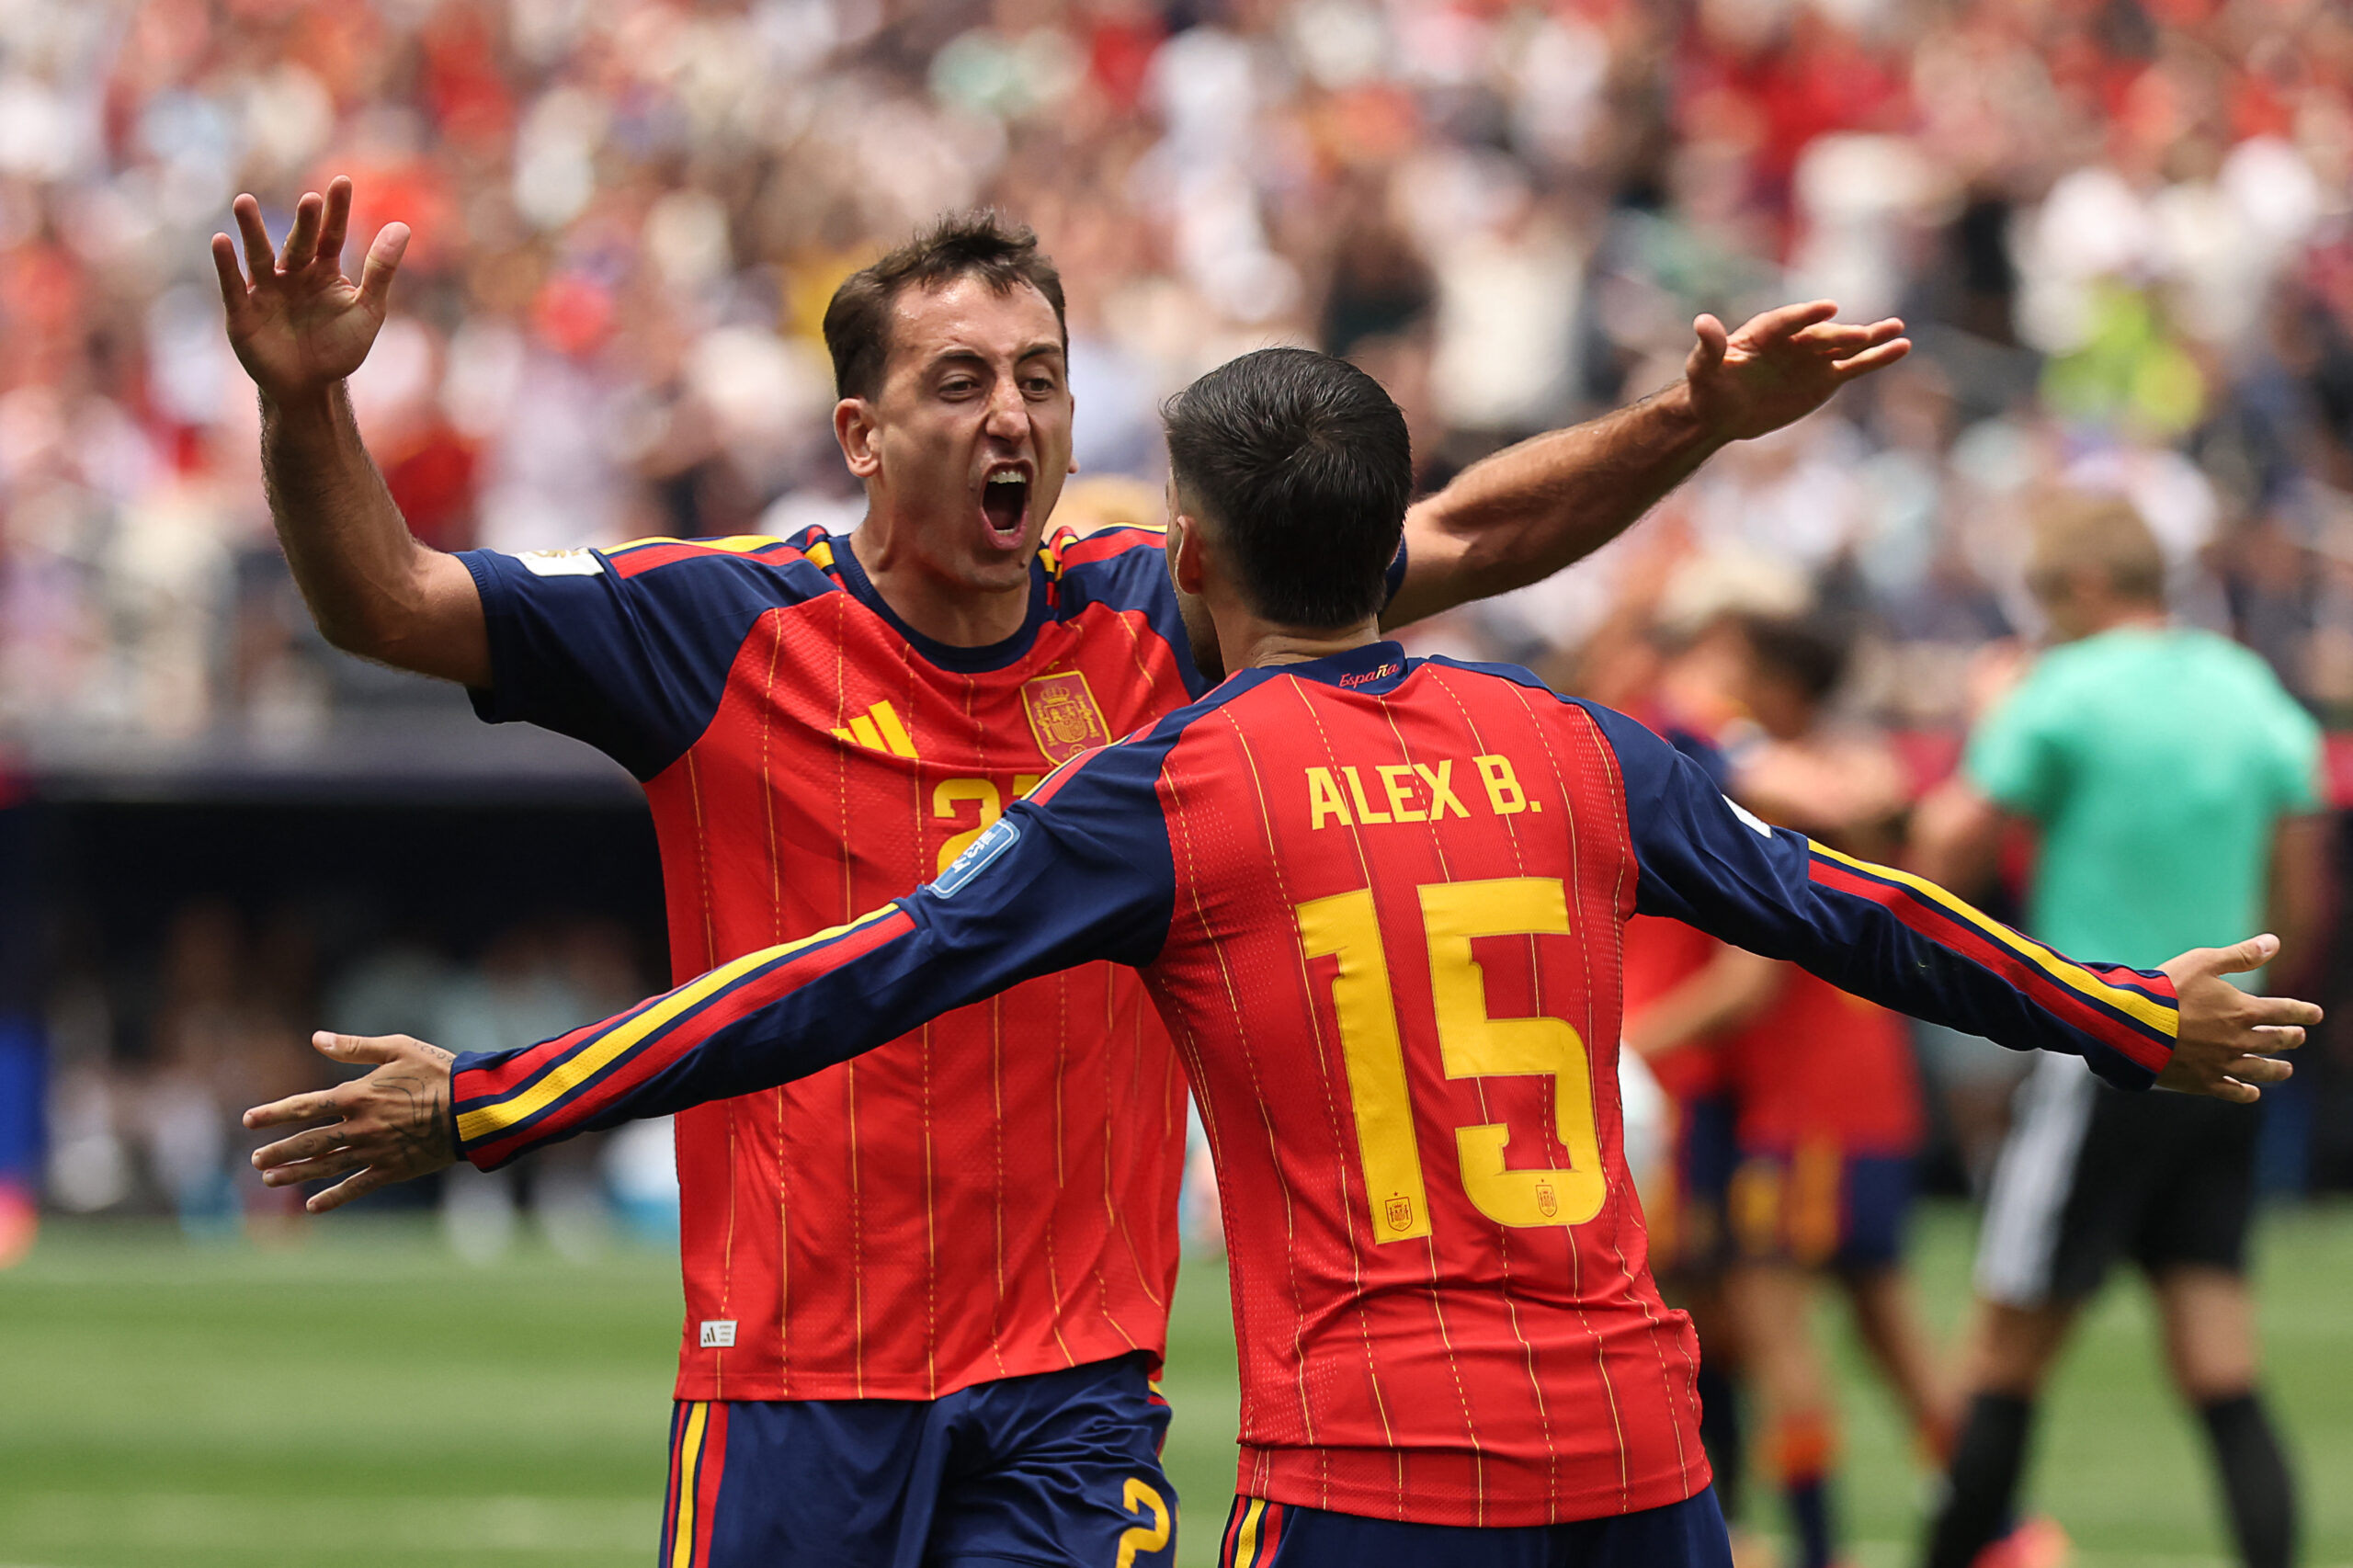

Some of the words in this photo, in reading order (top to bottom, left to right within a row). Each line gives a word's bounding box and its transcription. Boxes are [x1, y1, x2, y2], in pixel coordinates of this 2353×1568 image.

[1339, 664, 1399, 688] España
[932, 774, 1040, 876] 2
[1304, 759, 1471, 830] ALEX
[1472, 754, 1542, 816] B.
[1294, 877, 1607, 1245] 15
